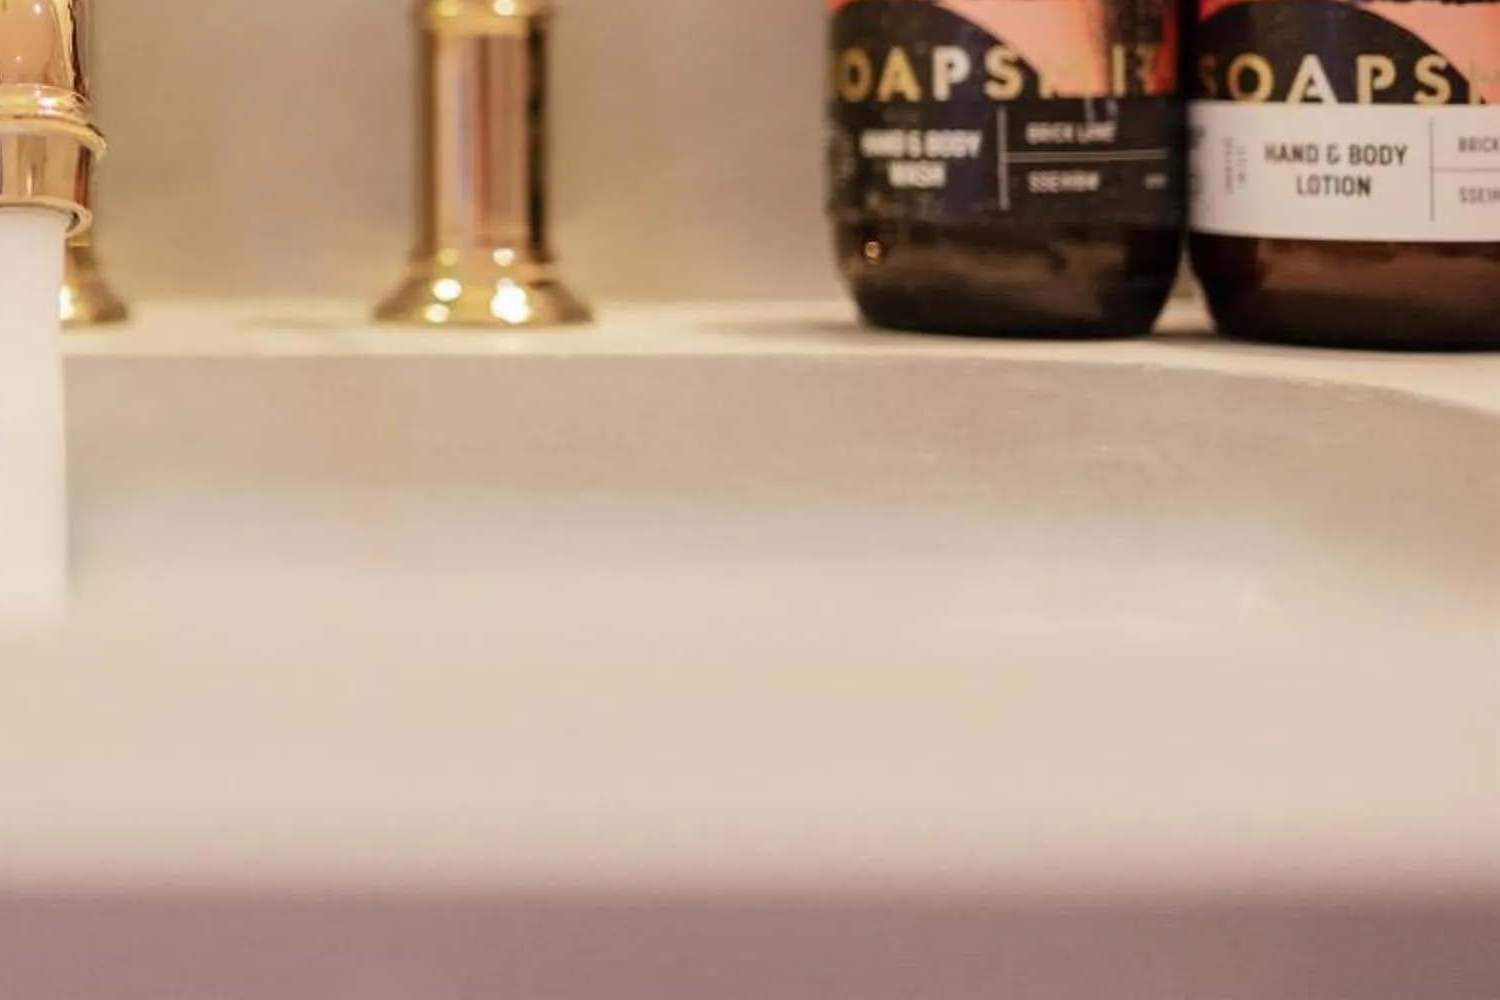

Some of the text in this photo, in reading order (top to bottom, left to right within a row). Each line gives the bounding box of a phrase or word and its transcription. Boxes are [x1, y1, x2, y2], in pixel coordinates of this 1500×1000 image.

[1264, 143, 1408, 166] HAND & BODY
[1296, 174, 1372, 197] LOTION
